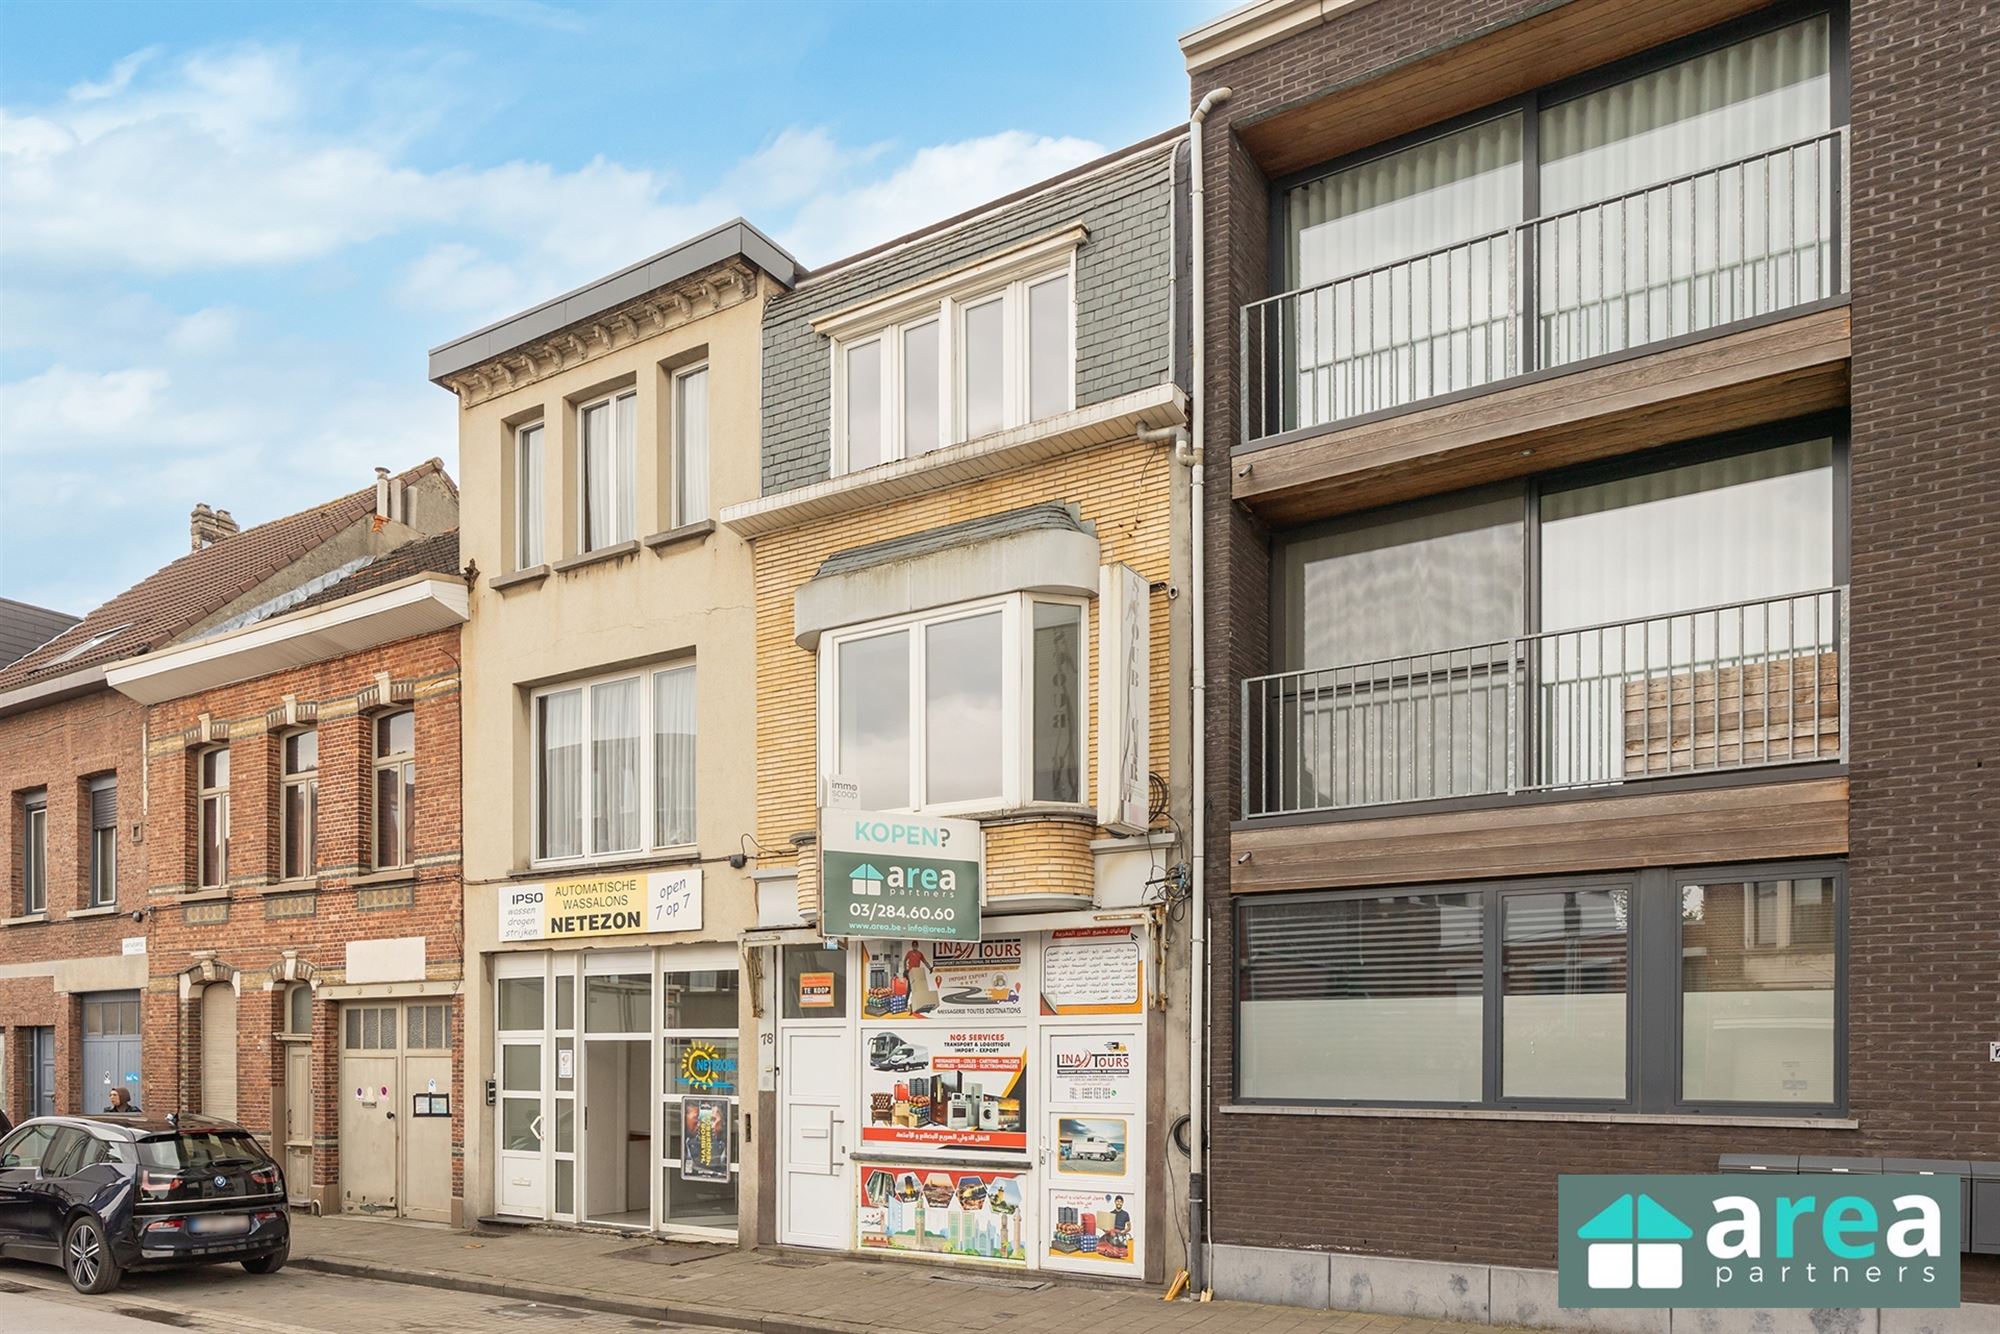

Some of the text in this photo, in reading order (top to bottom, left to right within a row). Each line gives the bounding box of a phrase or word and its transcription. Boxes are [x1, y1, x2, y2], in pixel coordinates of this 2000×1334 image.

[831, 779, 858, 791] immo
[831, 790, 858, 801] scoop
[855, 821, 951, 848] KOPEN?
[887, 866, 956, 890] area
[555, 880, 637, 896] AUTOMATISCHE
[659, 878, 687, 899] open
[889, 888, 955, 898] partners
[512, 892, 544, 905] IPSO
[563, 895, 629, 910] WASSALONS
[508, 907, 536, 916] wassen
[655, 892, 691, 921] 7 op 7
[849, 902, 955, 921] 03/284.60.60
[508, 917, 536, 927] drogen
[551, 911, 641, 933] NETEZON
[849, 922, 901, 931] www.area.be
[907, 923, 957, 934] info@area.be
[505, 929, 538, 938] strijken
[978, 939, 1021, 957] TOURS
[760, 1033, 774, 1045] 78
[969, 1033, 1005, 1041] SERVICES
[1056, 1054, 1129, 1068] LINA TOURS
